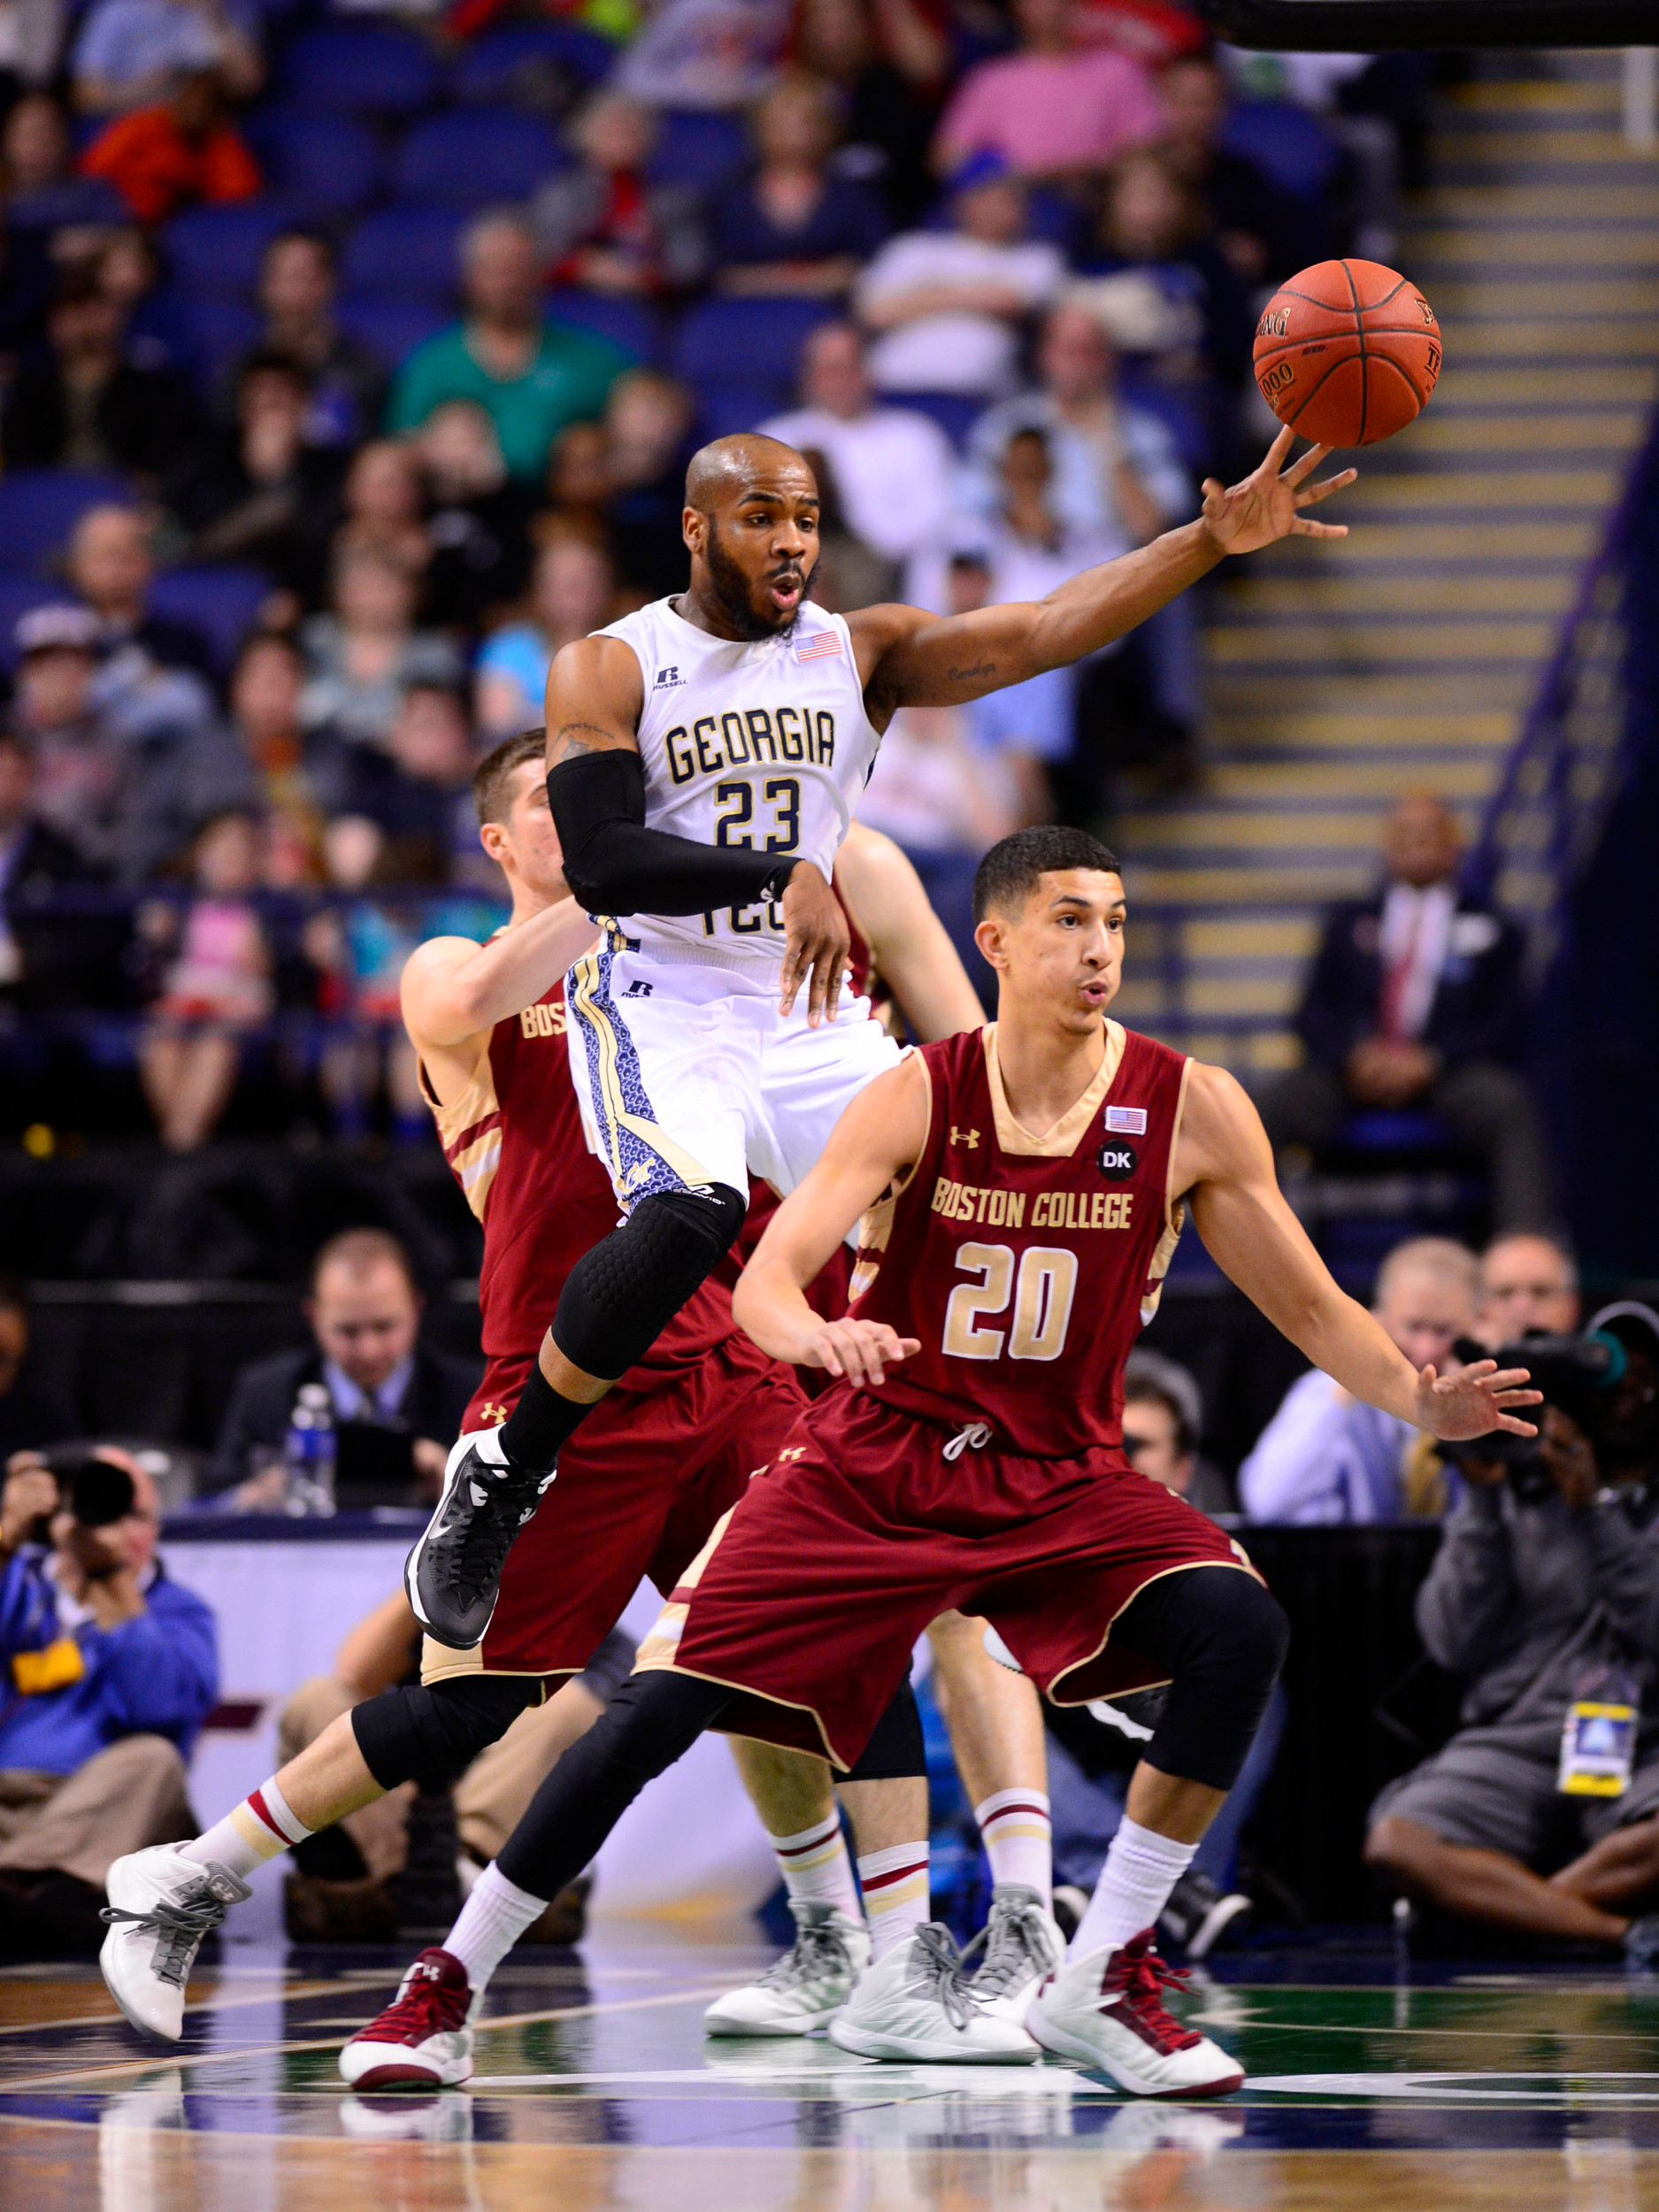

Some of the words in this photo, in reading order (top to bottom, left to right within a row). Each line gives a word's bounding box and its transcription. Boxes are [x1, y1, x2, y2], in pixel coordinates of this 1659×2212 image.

[652, 680, 688, 692] RUSSELL
[664, 706, 835, 786] GEORGIA
[714, 777, 802, 856] 23
[520, 1002, 568, 1040] BOS
[1102, 1151, 1132, 1169] DK
[931, 1177, 1026, 1228] BOSTON
[1031, 1192, 1134, 1229] COLLEGE
[941, 1241, 1079, 1361] 20
